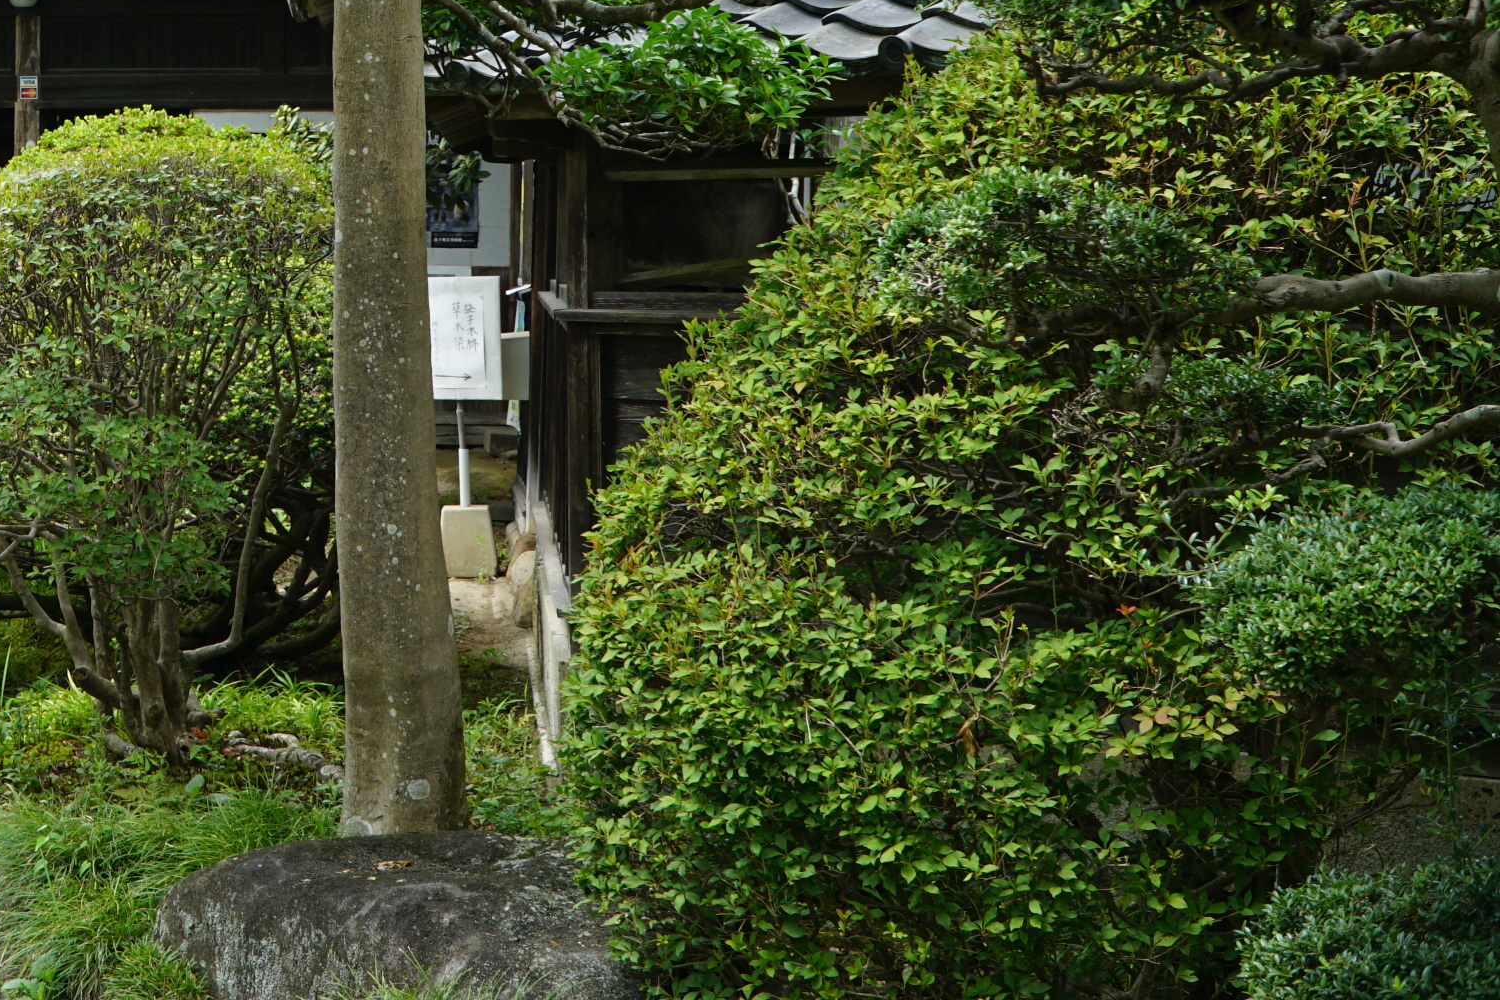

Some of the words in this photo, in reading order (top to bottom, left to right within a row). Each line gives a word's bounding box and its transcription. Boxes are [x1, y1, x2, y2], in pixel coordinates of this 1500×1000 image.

[452, 301, 464, 351] 草木染
[463, 301, 479, 352] 益子木綿
